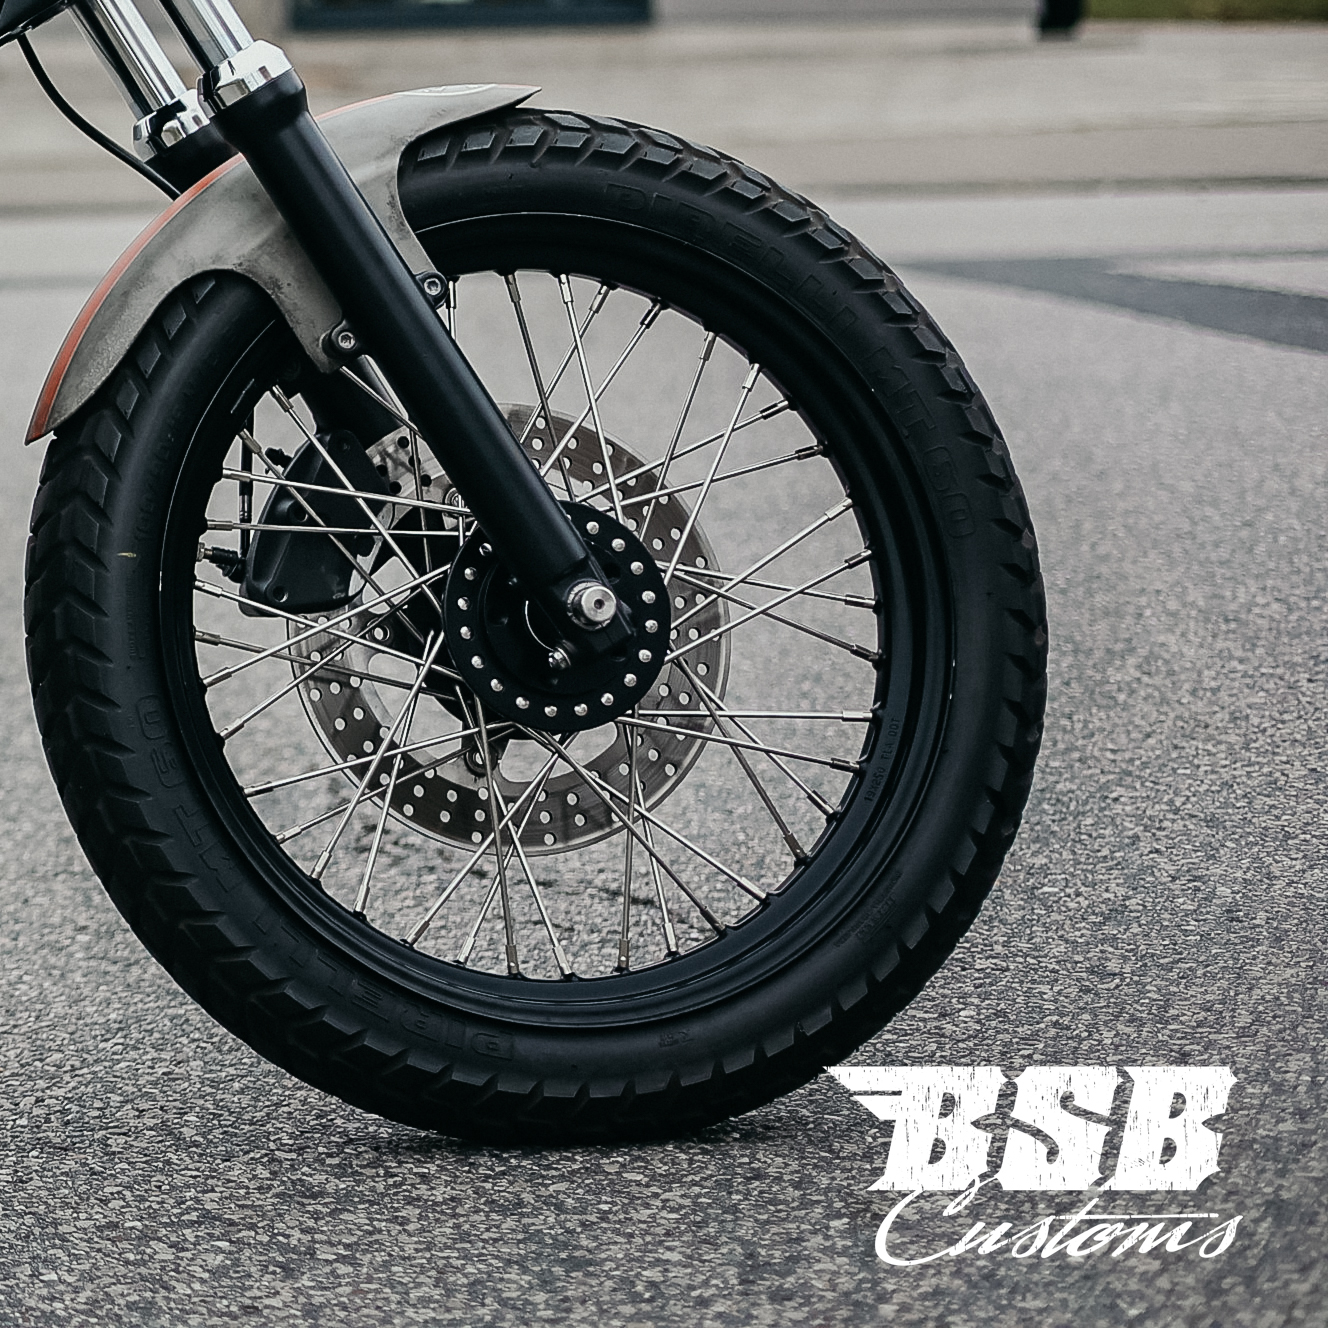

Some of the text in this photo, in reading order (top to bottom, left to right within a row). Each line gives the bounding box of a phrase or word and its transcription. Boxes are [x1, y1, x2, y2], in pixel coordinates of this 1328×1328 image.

[604, 180, 858, 338] PIRELLI
[134, 694, 518, 1061] PIRELLI MT 60
